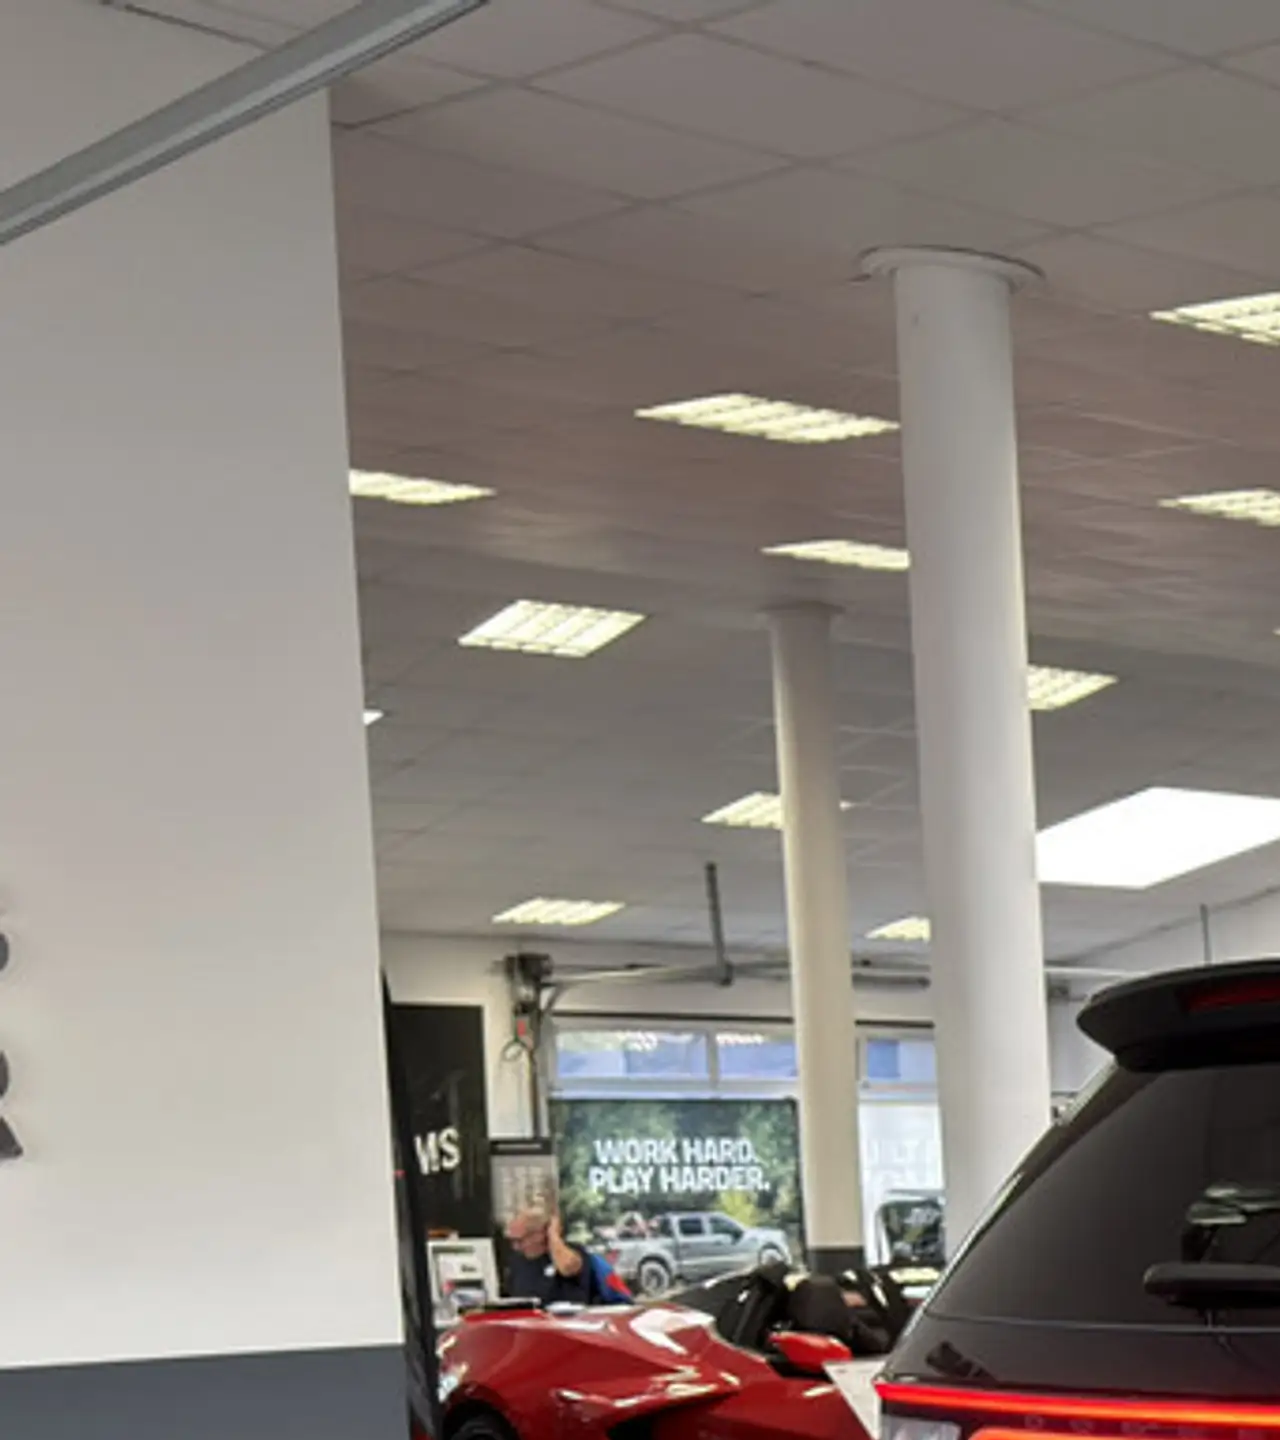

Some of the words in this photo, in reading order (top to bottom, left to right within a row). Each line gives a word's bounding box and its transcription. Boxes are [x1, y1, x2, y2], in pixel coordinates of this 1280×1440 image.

[593, 1138, 679, 1165] WORK
[682, 1137, 758, 1164] HARD.
[588, 1165, 654, 1195] PLAY
[659, 1165, 770, 1193] HARDER.
